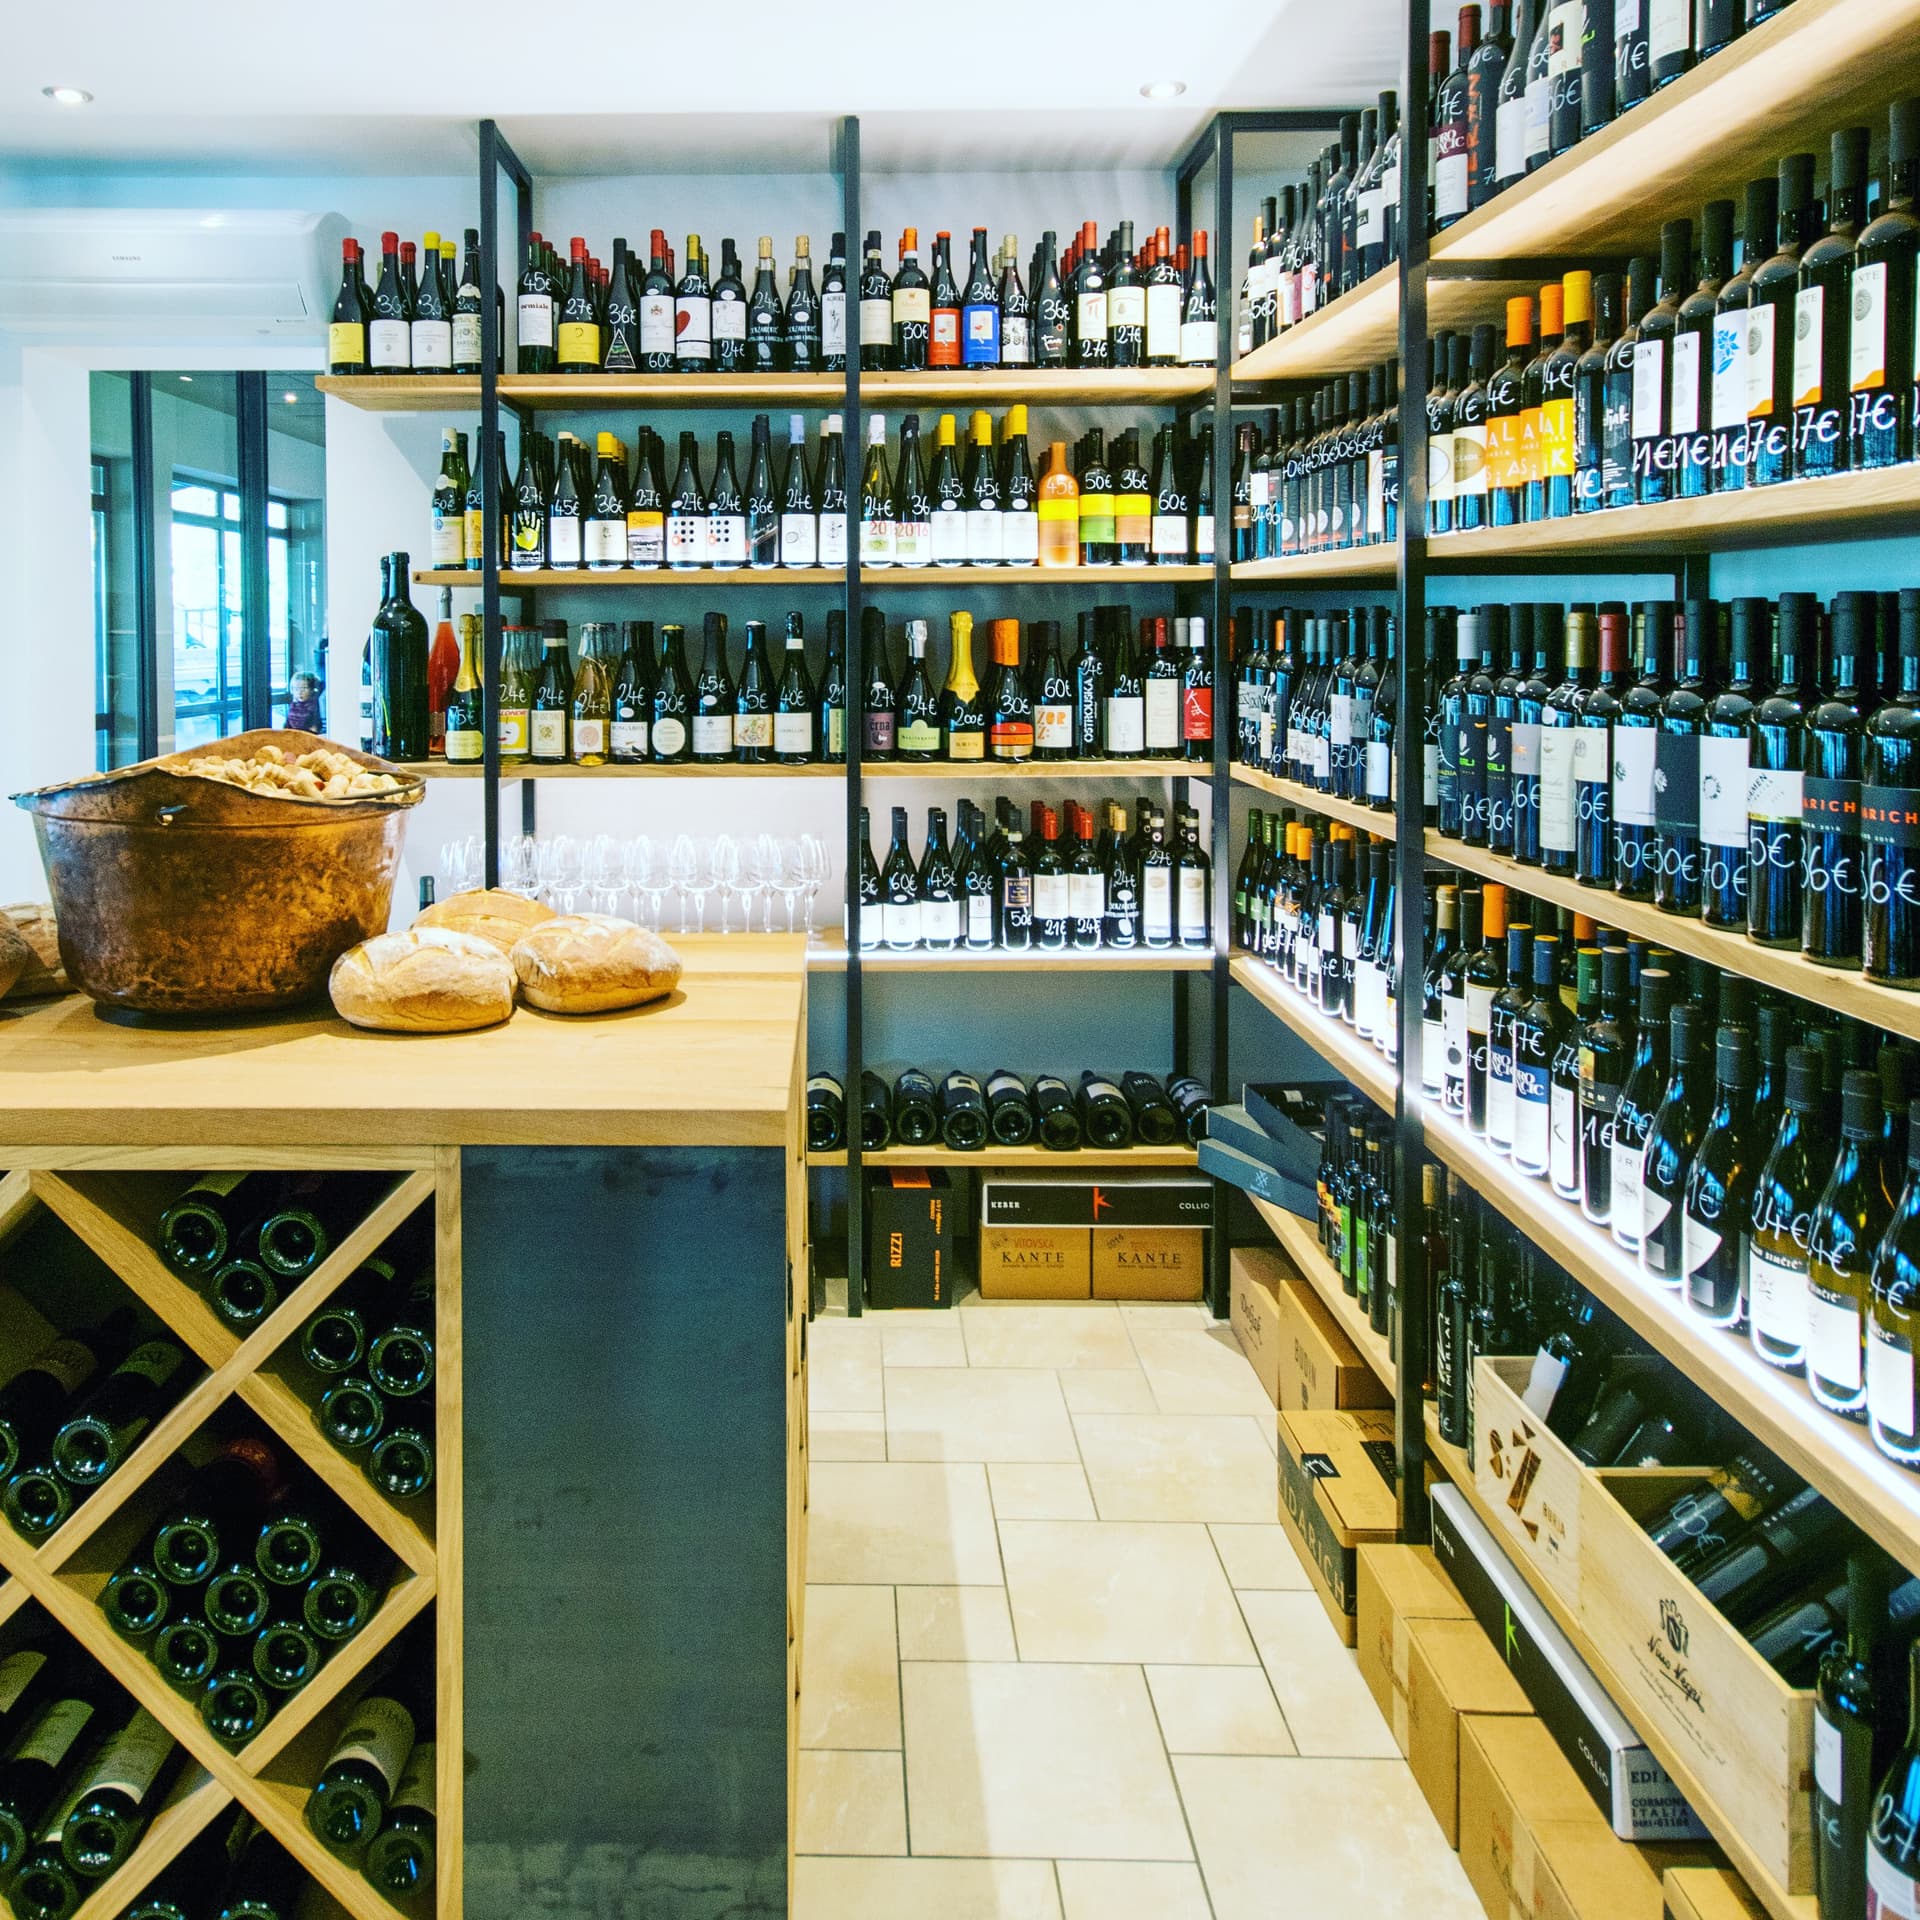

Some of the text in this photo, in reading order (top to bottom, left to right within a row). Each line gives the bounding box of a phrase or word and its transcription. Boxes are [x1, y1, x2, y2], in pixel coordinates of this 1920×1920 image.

[523, 272, 551, 292] 45€
[565, 298, 594, 316] 27€
[753, 291, 781, 314] 24€
[791, 290, 820, 310] 24€
[1042, 299, 1071, 321] 36€
[608, 303, 638, 326] 36€
[902, 321, 929, 340] 30€
[1117, 325, 1143, 344] 27€
[721, 340, 745, 358] 24€
[1082, 339, 1109, 359] 27€
[648, 352, 674, 369] 60€
[1085, 472, 1113, 491] 50€
[1120, 469, 1149, 491] 36€
[553, 498, 580, 516] 45€
[635, 488, 662, 508] 27€
[682, 491, 705, 512] 27€
[718, 491, 742, 512] 24€
[750, 498, 774, 515] 36€
[786, 488, 812, 511] 24€
[864, 496, 894, 517] 24€
[1158, 489, 1188, 512] 60€
[699, 675, 728, 696] 45€
[1045, 677, 1072, 698] 60€
[1118, 674, 1140, 694] 21€
[537, 686, 566, 706] 24€
[618, 683, 646, 706] 24€
[655, 690, 687, 714] 30€
[1000, 694, 1032, 715] 30€
[907, 694, 937, 716] 24€
[954, 706, 985, 727] 200€
[889, 872, 918, 892] 60€
[930, 866, 958, 887] 45€
[968, 871, 994, 891] 36€
[1044, 919, 1068, 937] 21€
[1179, 1202, 1210, 1210] COLLIO
[890, 1232, 903, 1268] RIZZI
[1002, 1251, 1065, 1264] KANTE
[1117, 1252, 1181, 1264] KANTE
[1631, 1770, 1659, 1785] EDI
